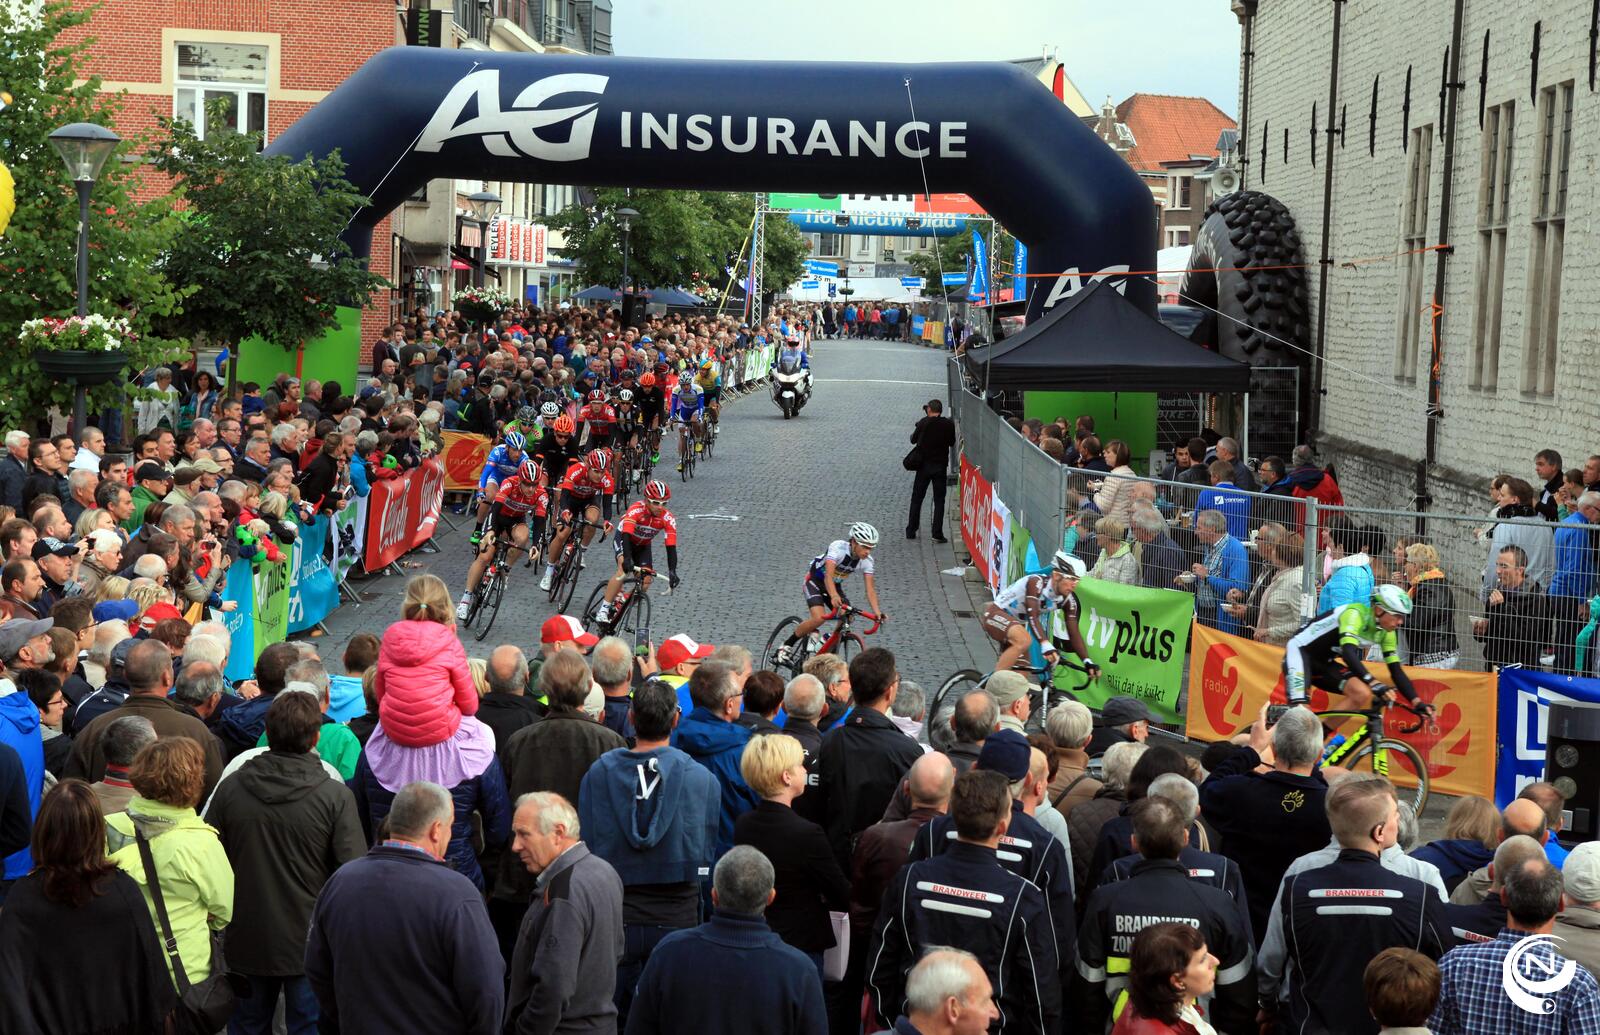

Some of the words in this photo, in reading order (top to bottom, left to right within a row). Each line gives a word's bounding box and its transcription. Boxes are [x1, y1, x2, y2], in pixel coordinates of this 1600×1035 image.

[415, 69, 609, 162] AG
[620, 111, 968, 158] INSURANCE
[847, 210, 957, 229] Nieuwblad
[1121, 678, 1135, 695] dat
[1135, 681, 1143, 698] je
[1204, 678, 1239, 696] radio
[932, 884, 987, 900] BRANDWEER
[1325, 889, 1384, 897] BRANDWEER
